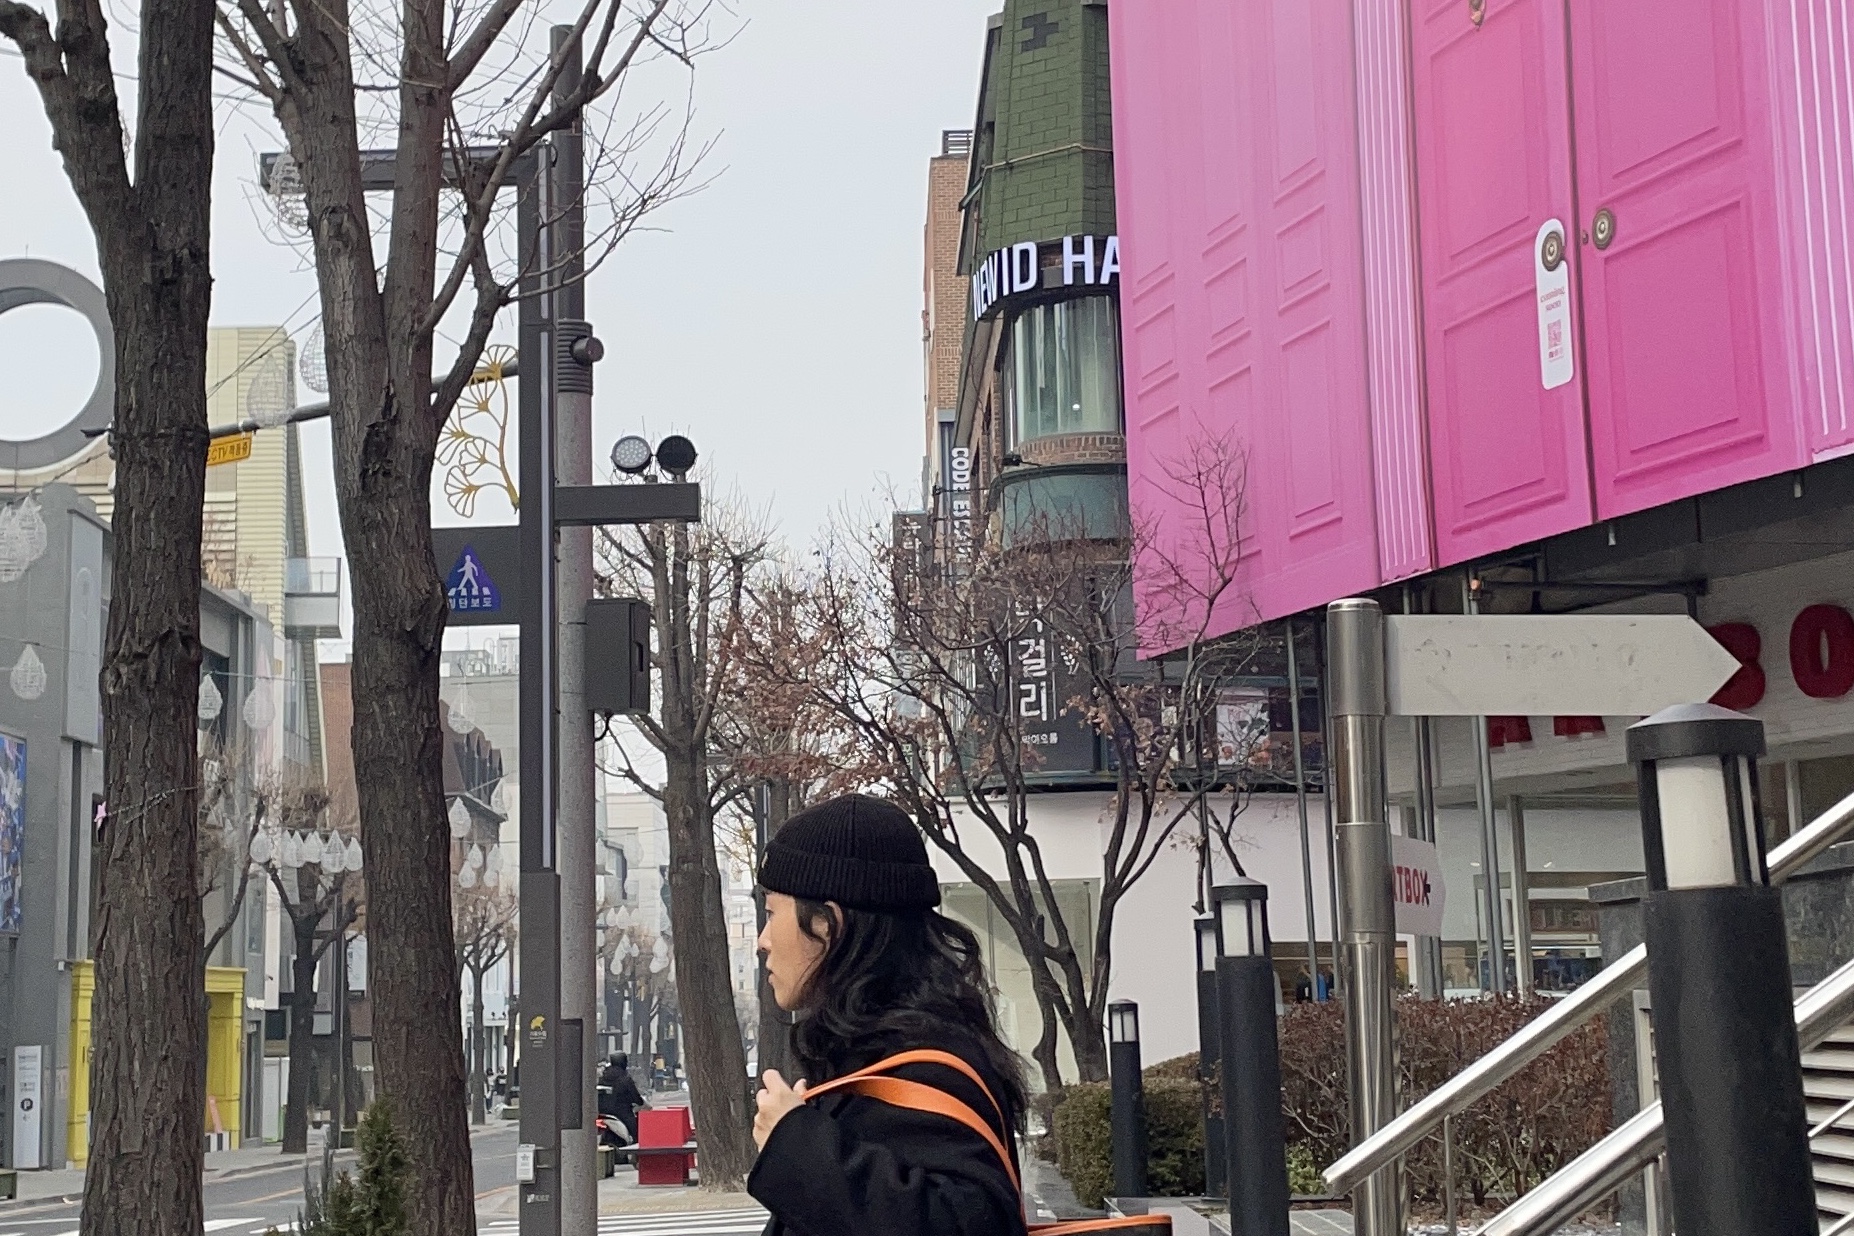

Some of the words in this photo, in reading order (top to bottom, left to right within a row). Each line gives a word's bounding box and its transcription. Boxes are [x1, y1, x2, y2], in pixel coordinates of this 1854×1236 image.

[972, 241, 1037, 322] NEWID
[951, 447, 970, 492] CODE
[1393, 865, 1431, 908] TBOX
